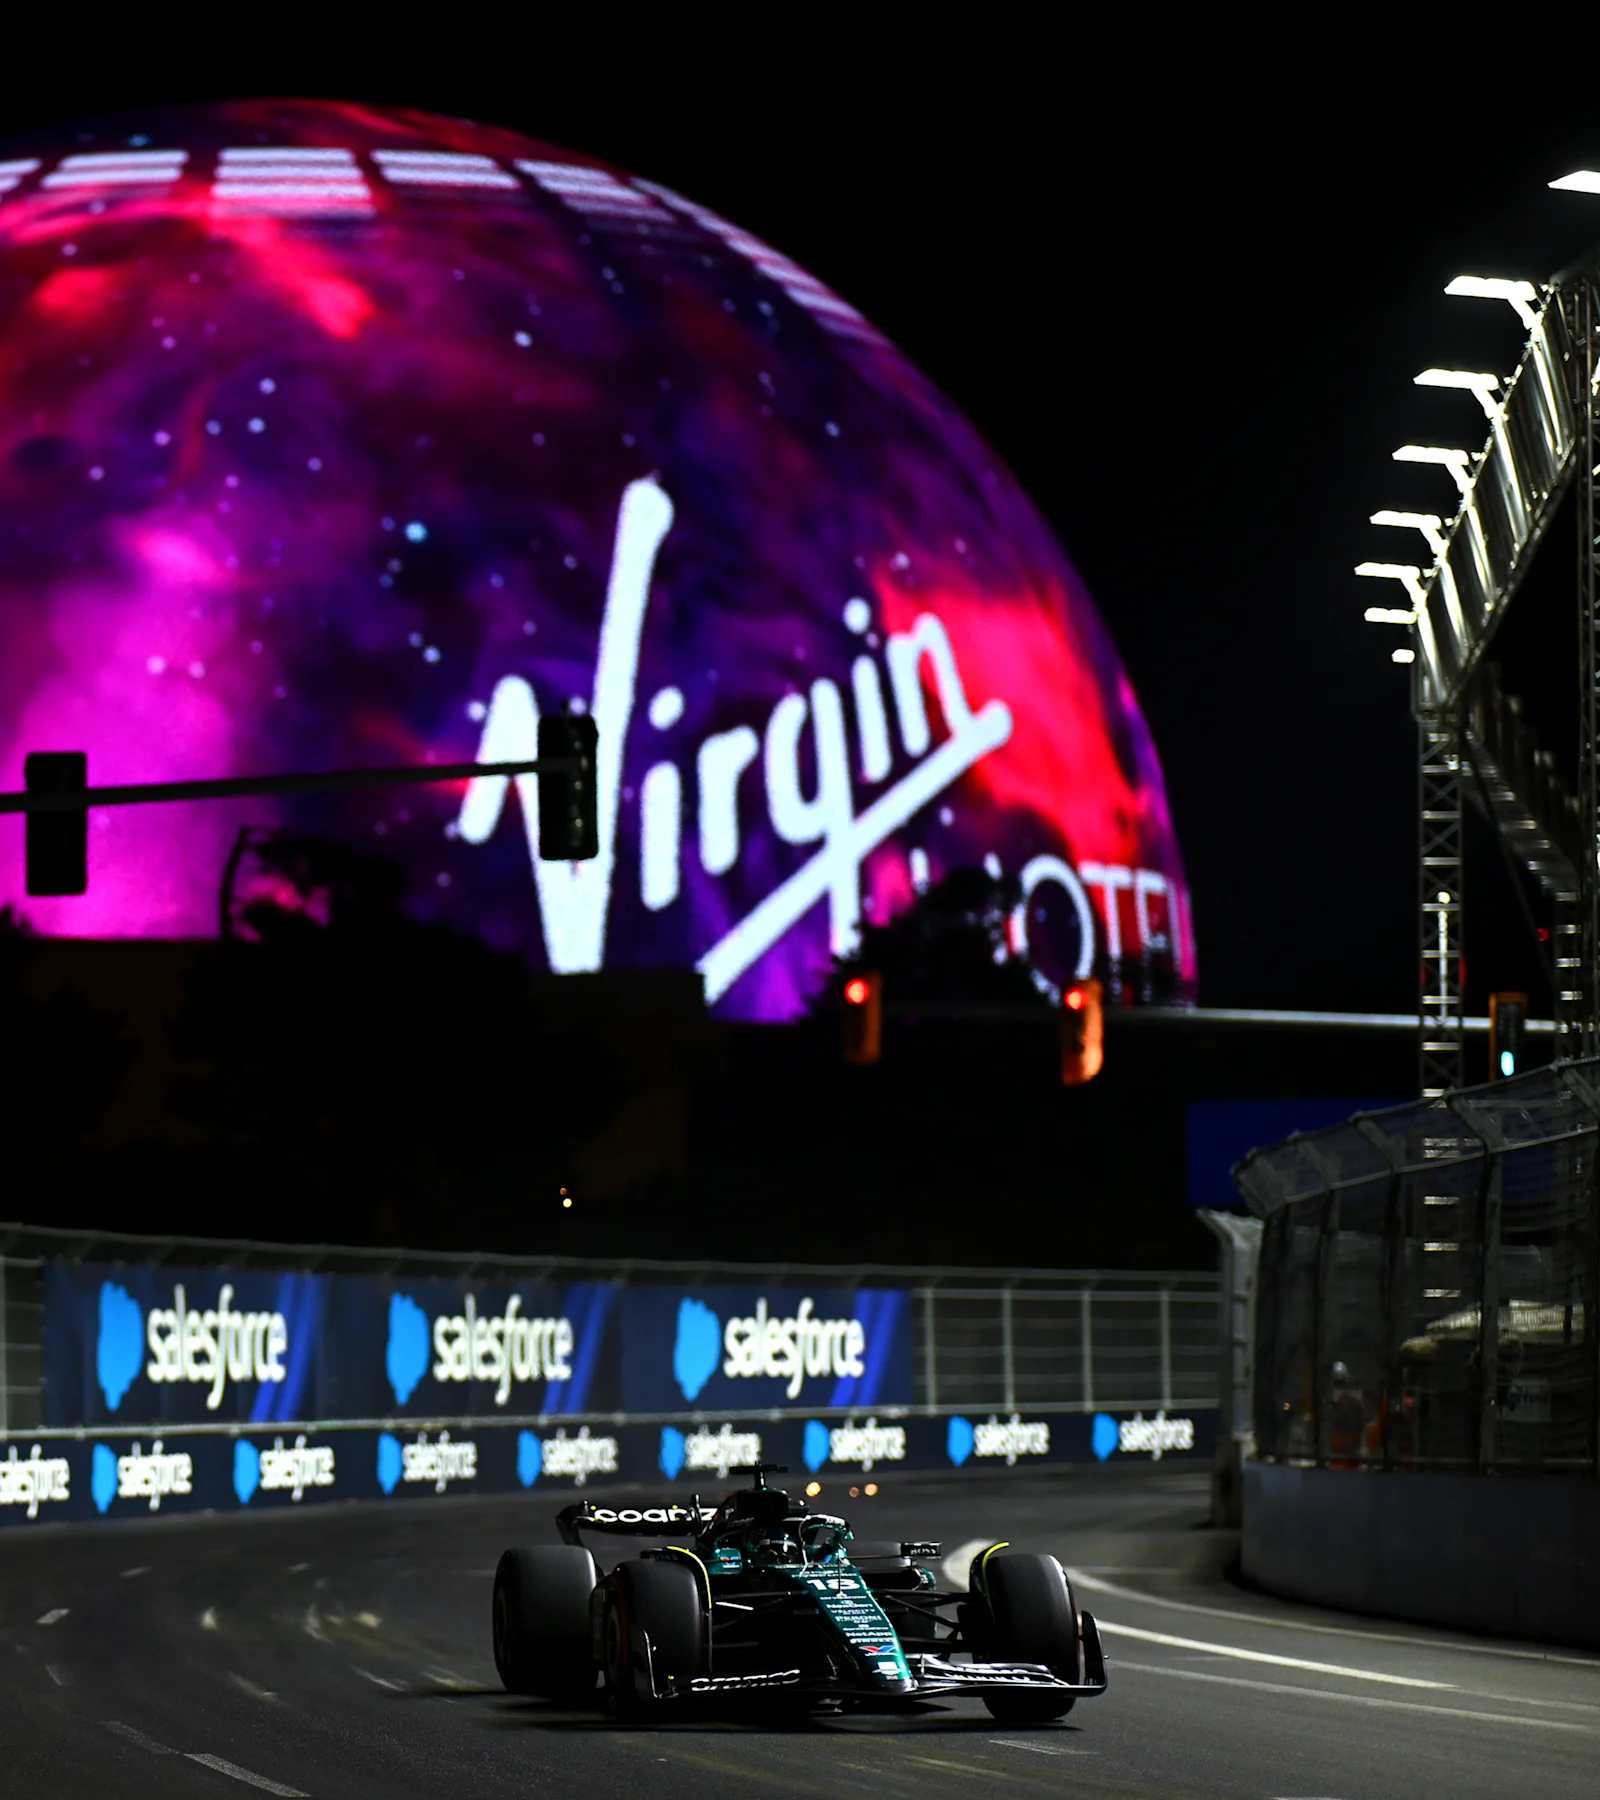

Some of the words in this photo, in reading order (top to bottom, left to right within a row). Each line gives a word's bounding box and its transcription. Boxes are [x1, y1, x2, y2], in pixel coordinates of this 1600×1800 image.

[458, 478, 1012, 1003] Virgin
[147, 1284, 288, 1410] salesforce
[433, 1294, 574, 1405] salesforce
[723, 1297, 865, 1400] salesforce
[259, 1435, 335, 1501] salesforce
[542, 1427, 618, 1486] salesforce
[830, 1417, 906, 1471] salesforce
[974, 1414, 1050, 1465] salesforce
[1120, 1410, 1194, 1460] salesforce
[117, 1440, 192, 1510] salesforce
[806, 1578, 861, 1591] 18
